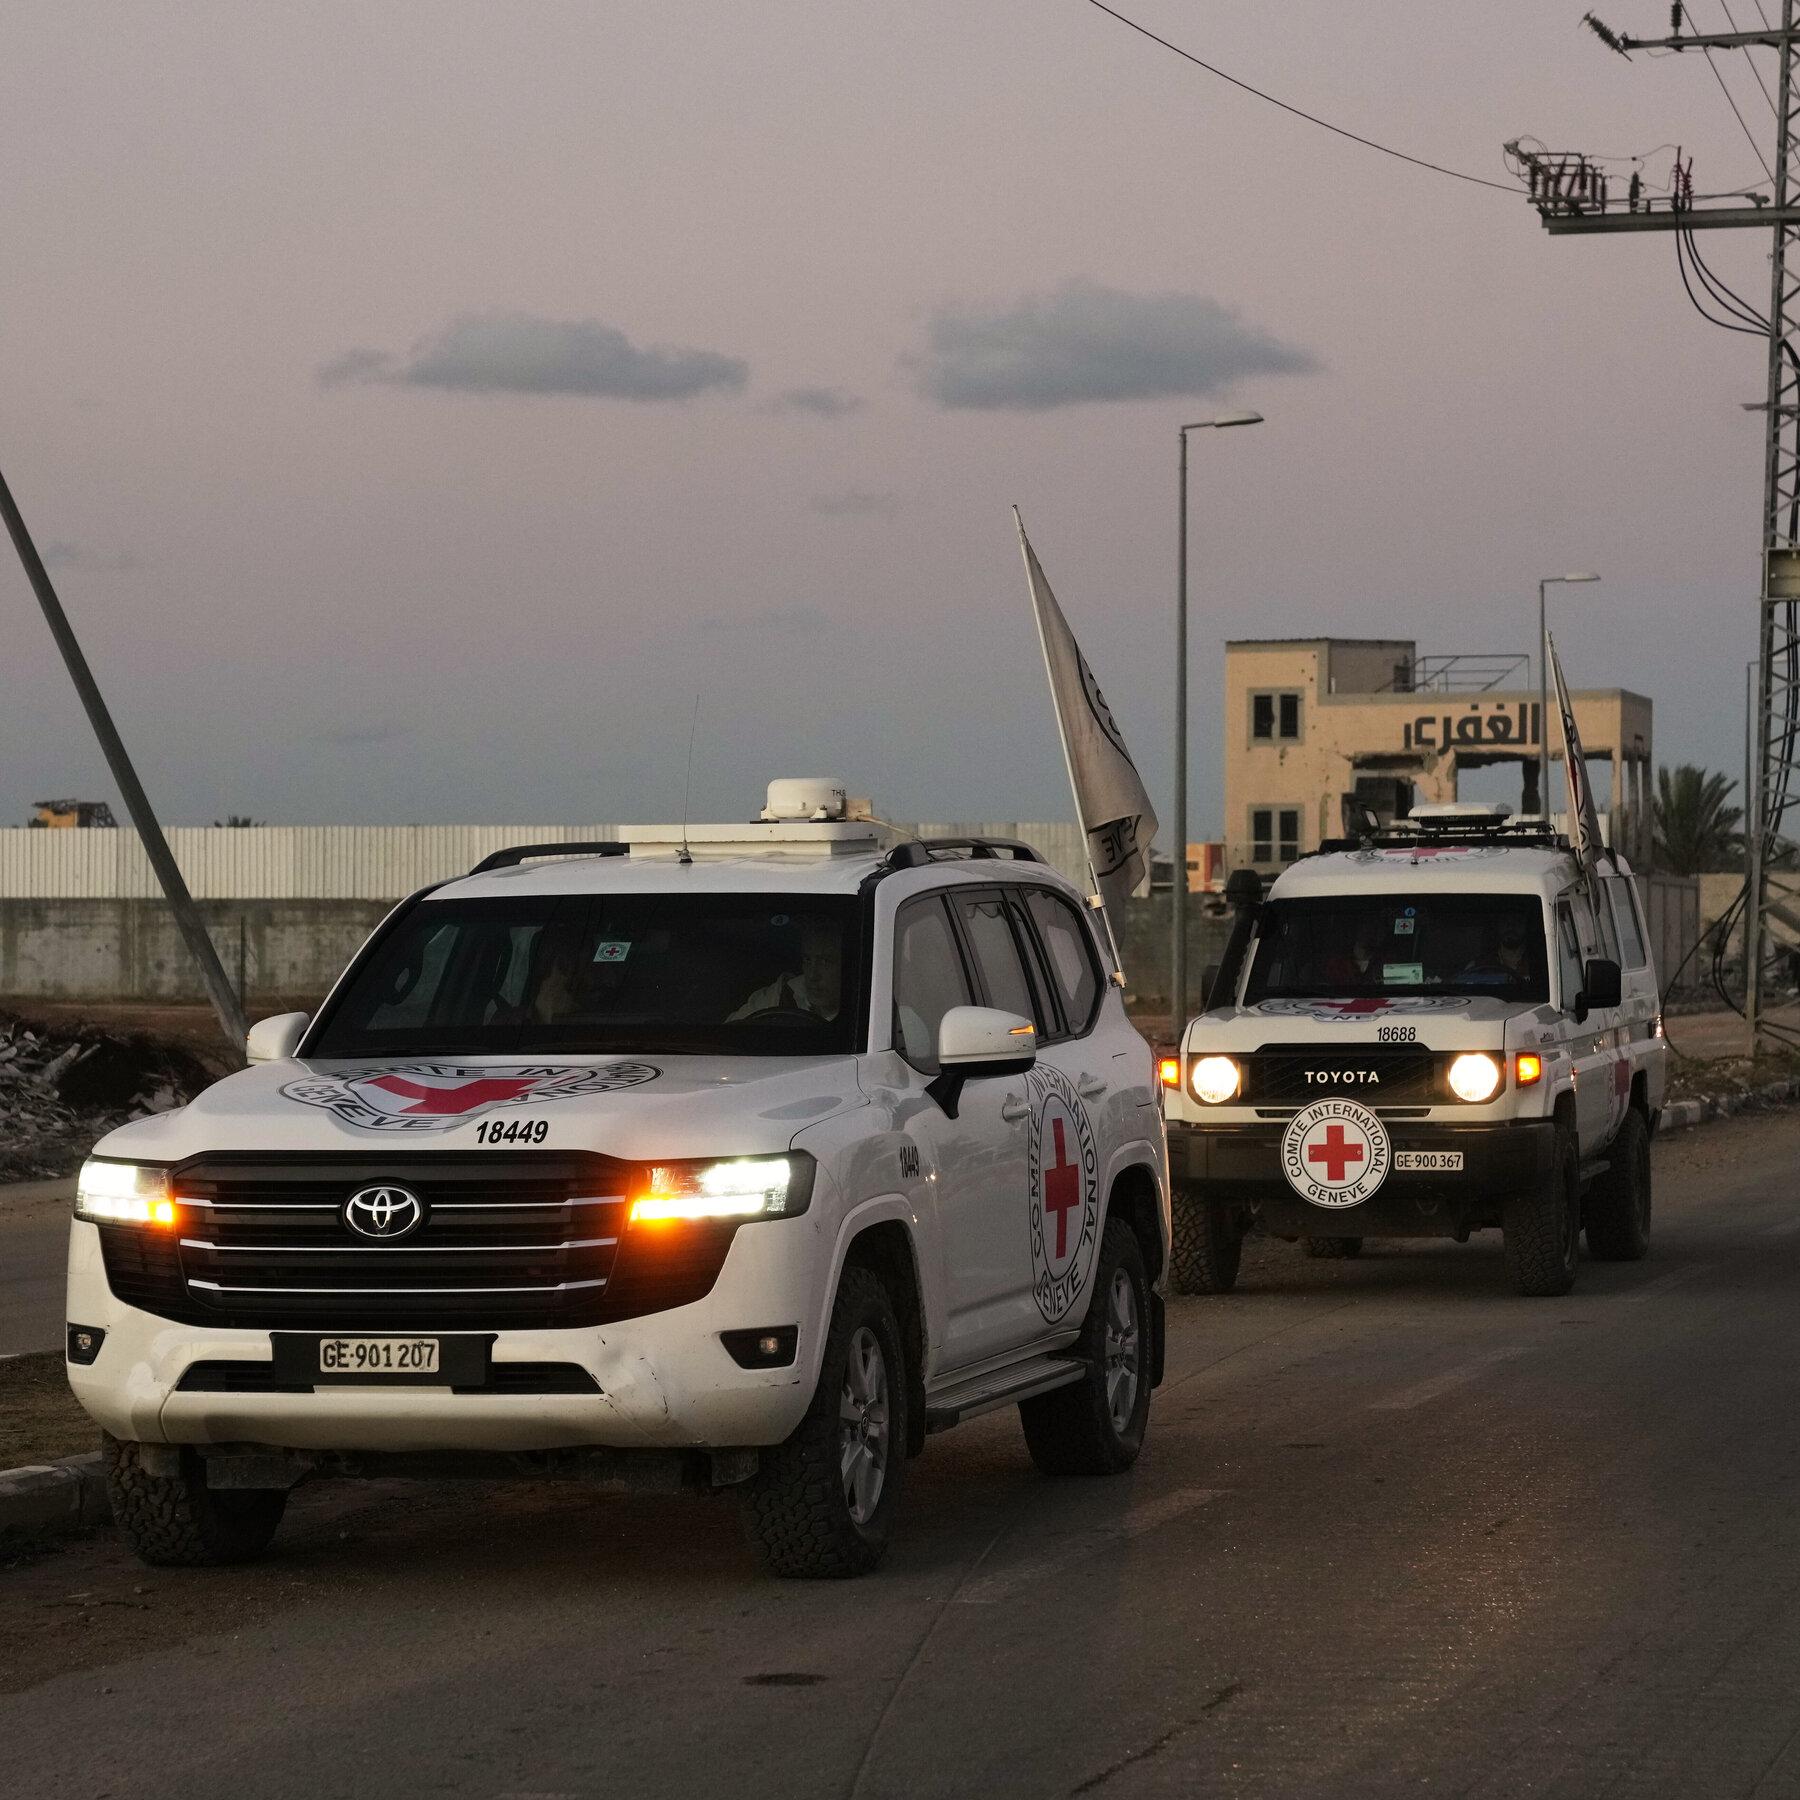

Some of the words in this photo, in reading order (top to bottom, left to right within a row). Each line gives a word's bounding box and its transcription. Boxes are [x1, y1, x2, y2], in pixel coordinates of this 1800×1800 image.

[1376, 1026, 1417, 1042] 18688
[1304, 1071, 1380, 1084] TOYOTA
[475, 1120, 549, 1144] 18449
[1286, 1121, 1308, 1178] COMITE
[1307, 1103, 1386, 1176] INTERNATIONAL
[1307, 1181, 1369, 1204] GENEVE
[1035, 1263, 1082, 1315] GENEVE
